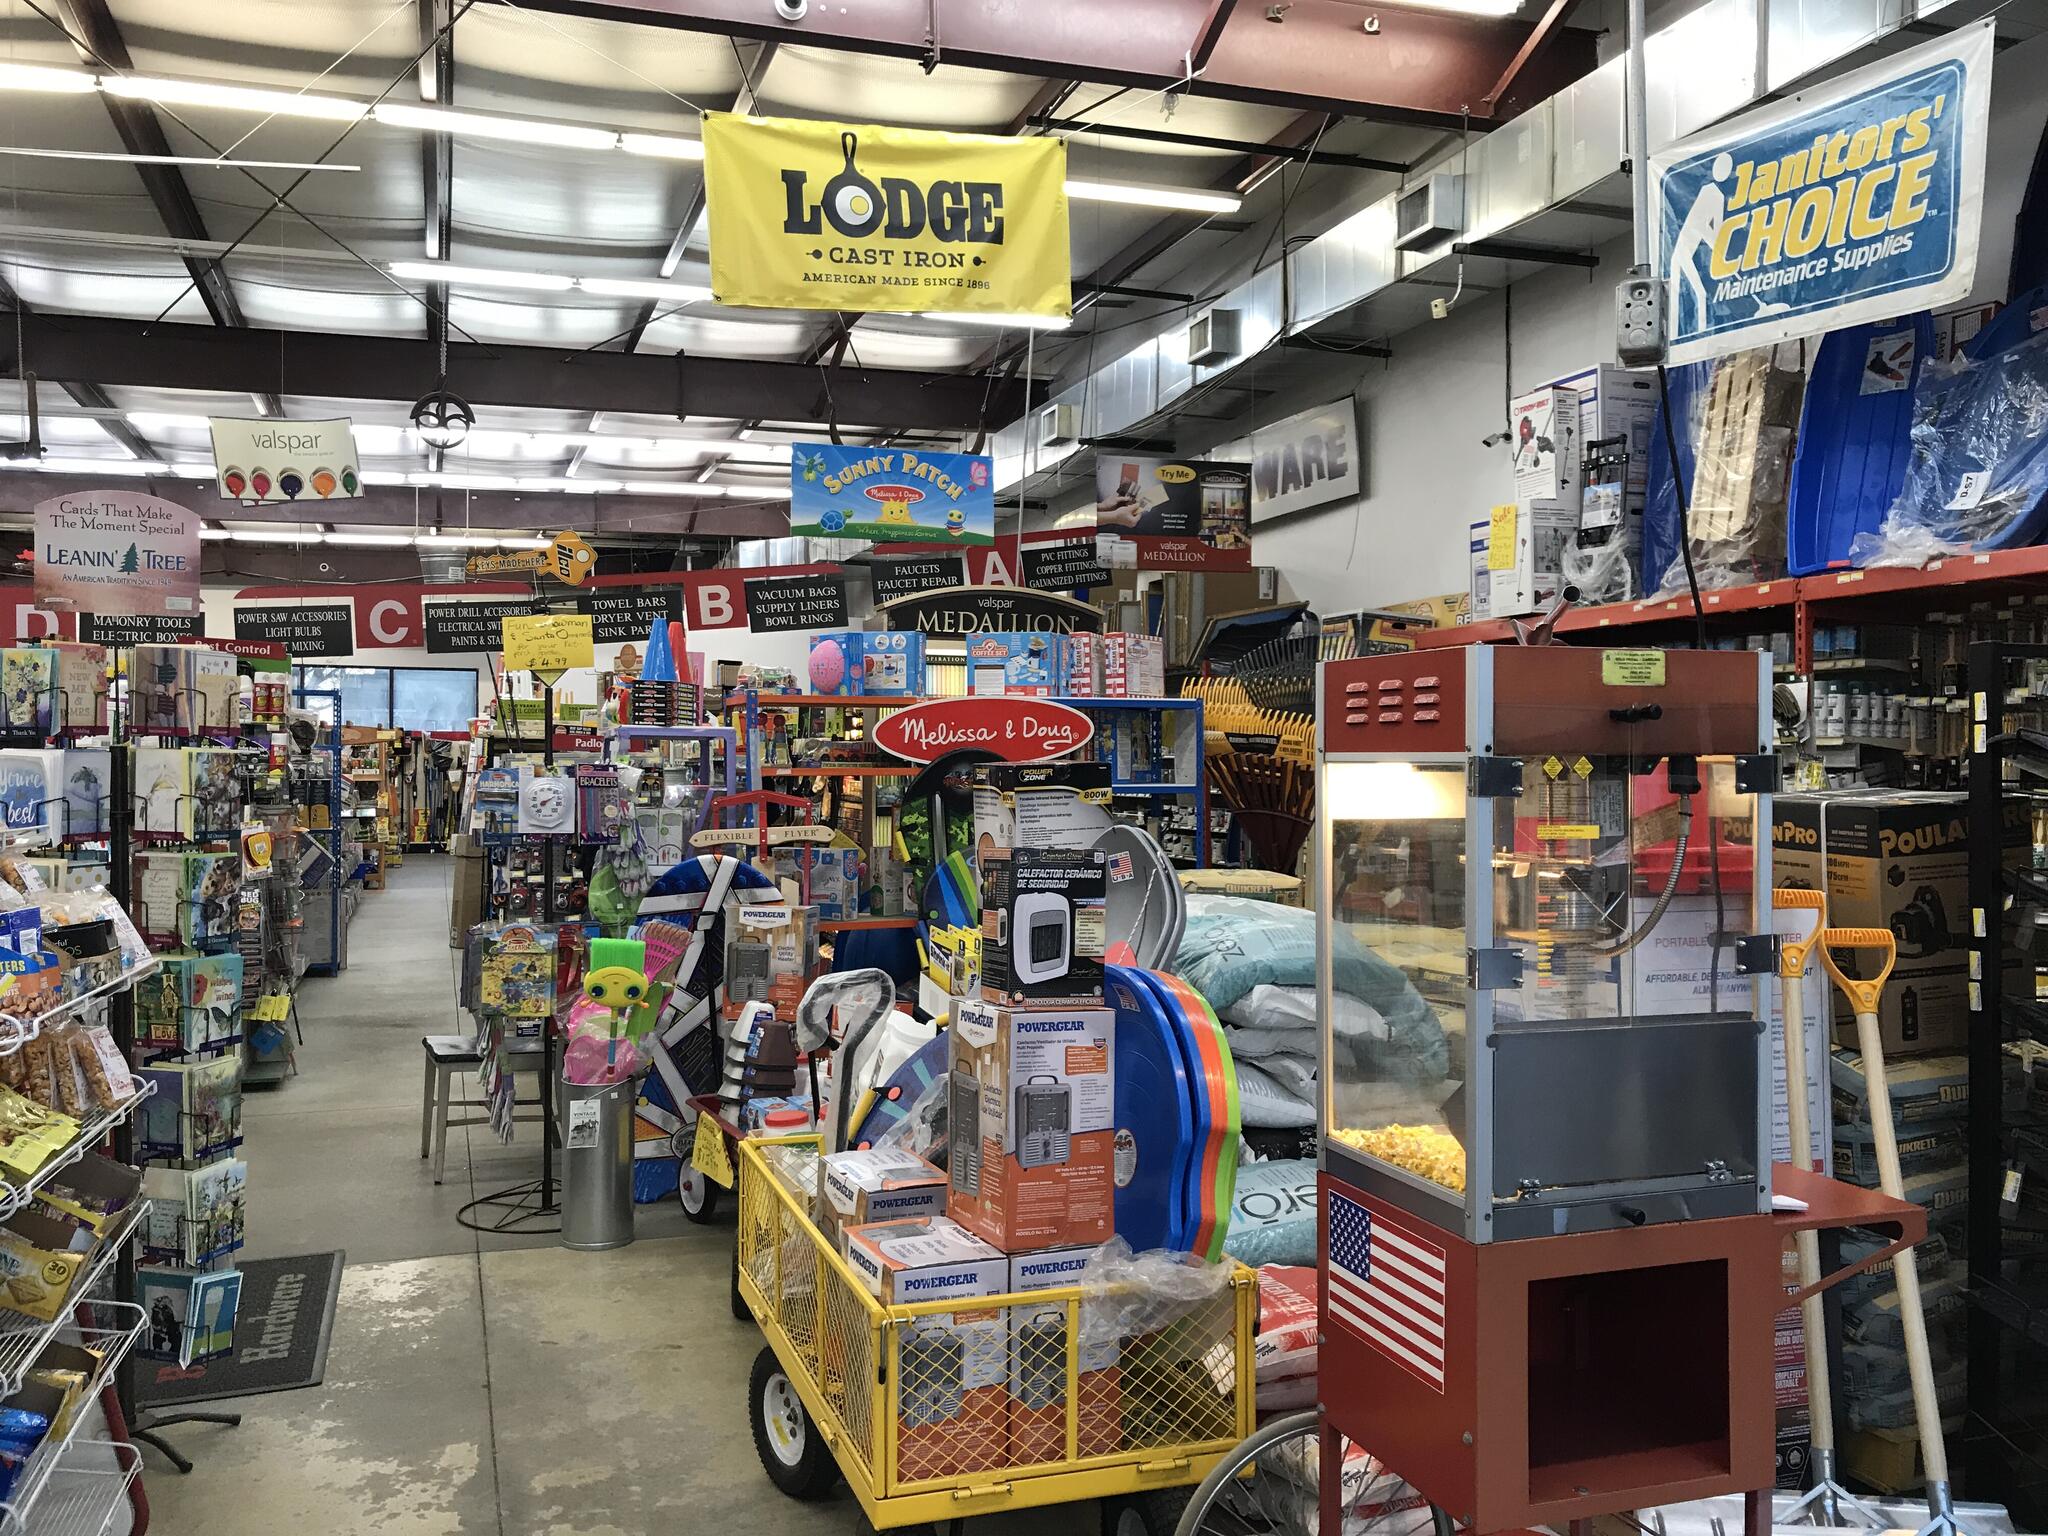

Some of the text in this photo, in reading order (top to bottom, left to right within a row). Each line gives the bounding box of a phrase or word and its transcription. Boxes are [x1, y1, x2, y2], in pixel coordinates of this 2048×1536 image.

[781, 166, 1003, 245] LODGE
[1709, 150, 1938, 280] CHOICE
[829, 247, 964, 268] CAST IRON
[1713, 232, 1913, 303] Maintenance Supplies
[802, 272, 990, 290] AMERICAN MADE SINCE 1896
[252, 430, 322, 453] valspar
[823, 453, 965, 501] SUNNY PATCH
[1161, 469, 1190, 480] Try Me
[60, 501, 172, 520] Cards That Make
[50, 515, 185, 536] The Moment Special
[1160, 542, 1188, 552] valspar
[47, 543, 187, 571] LEANIN' TREE
[557, 543, 574, 577] ilco
[1041, 548, 1089, 562] PVC FITTINGS
[1144, 551, 1206, 562] MEDALLION
[476, 556, 546, 571] KEYS MADE HERE
[895, 564, 940, 576] FAUCETS
[983, 551, 1015, 586] A
[1036, 560, 1097, 575] COPPER FITTINGS
[62, 573, 72, 582] AN
[73, 574, 105, 584] AMERICAN
[106, 576, 138, 585] TRADITION
[877, 576, 959, 590] FAUCET REPAIR
[1029, 571, 1108, 588] GALVANIZED FITTINGS
[757, 586, 837, 600] VACUUM BAGS
[592, 597, 667, 610] TOWEL BARS
[698, 585, 734, 626] B
[756, 599, 840, 615] SUPPLY LINERS
[977, 597, 1015, 610] valspar
[237, 610, 347, 624] POWER SAW ACCESSORIES
[428, 605, 532, 619] POWER DRILL ACCESSORIES
[592, 610, 669, 625] DRYER VENT
[155, 617, 191, 628] TOOLS
[368, 599, 409, 644] C
[438, 622, 486, 632] ELECTRICAL
[765, 613, 835, 628] BOWL RINGS
[917, 610, 1076, 633] MEDALLION
[265, 626, 322, 638] LIGHT BULBS
[598, 625, 652, 638] SINK PAR
[292, 640, 325, 652] MIXING
[451, 636, 486, 646] PAINTS &
[225, 643, 271, 655] Control
[69, 673, 92, 682] NEW
[900, 717, 1073, 750] Melissa & Doug
[575, 737, 603, 748] Padlo
[580, 777, 617, 787] BRACELETS
[1083, 790, 1109, 799] 800W
[8, 799, 42, 824] best
[704, 829, 817, 841] FLEXIBLE FLYER
[1879, 817, 1968, 858] POULA
[1017, 867, 1102, 879] CALEFACTOR CERÁMICO
[1017, 879, 1070, 889] DE SEGURIDAD
[241, 890, 260, 898] BED
[1017, 1021, 1085, 1032] POWERGEAR
[1898, 1138, 1938, 1154] UIKRETE
[827, 1172, 854, 1202] POWERGEAR
[873, 1194, 934, 1210] POWERGEAR
[49, 1261, 67, 1276] 30
[850, 1246, 878, 1279] POWERGEAR
[905, 1272, 978, 1291] POWERGEAR
